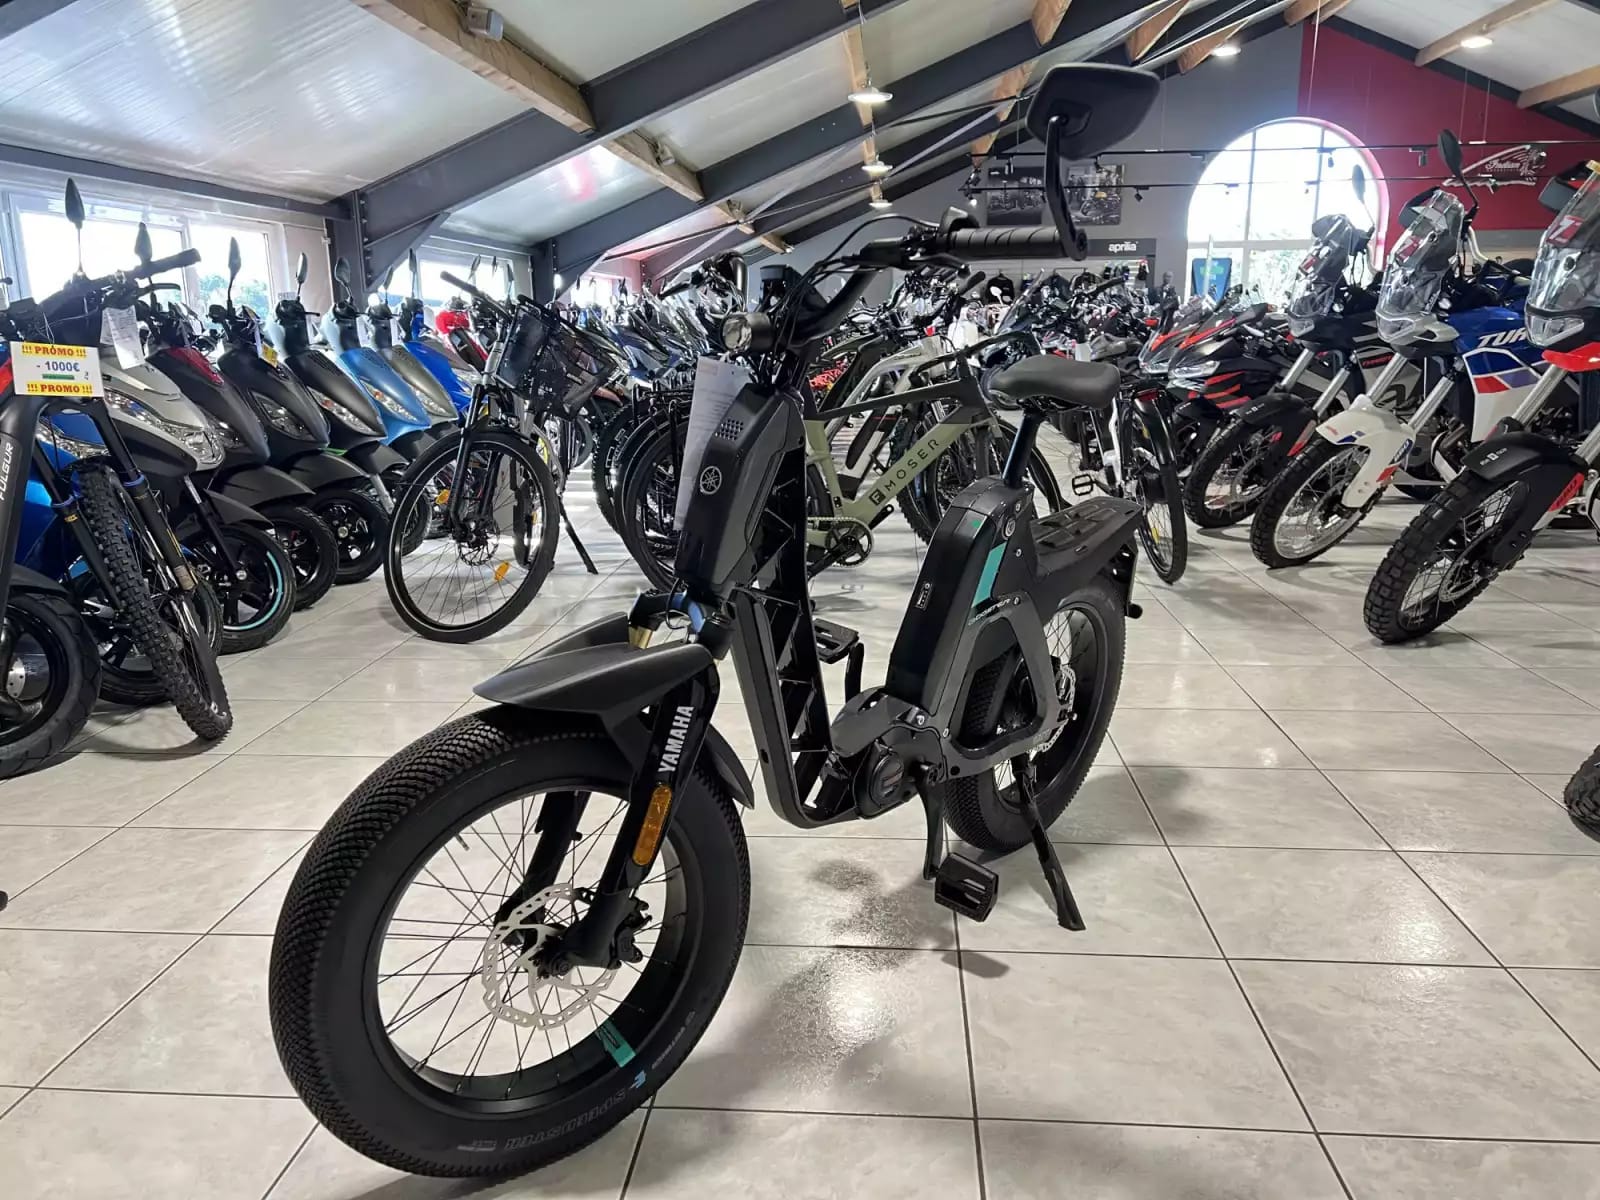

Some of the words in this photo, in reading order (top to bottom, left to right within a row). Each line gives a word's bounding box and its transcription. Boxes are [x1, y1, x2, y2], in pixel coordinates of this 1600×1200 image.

[1108, 241, 1137, 253] aprilia
[34, 345, 75, 356] PROMO
[45, 361, 80, 372] 1000€
[40, 384, 80, 393] PROMO
[884, 439, 939, 492] MOSER
[658, 706, 694, 772] YAMAHA
